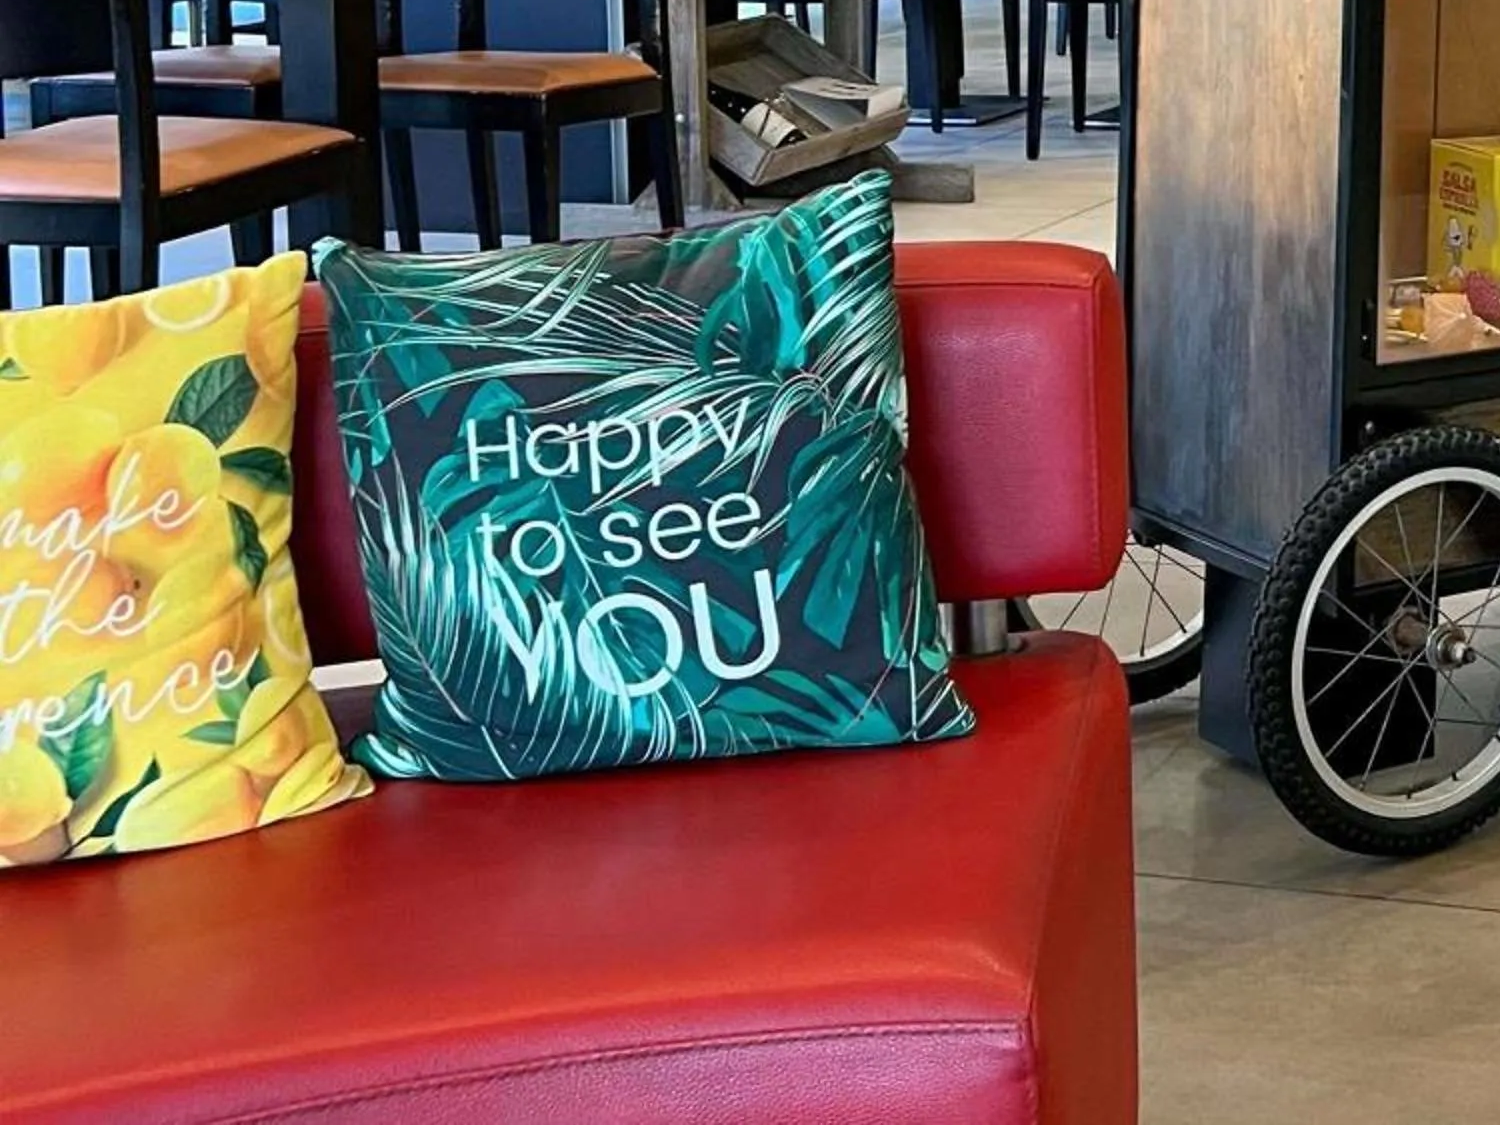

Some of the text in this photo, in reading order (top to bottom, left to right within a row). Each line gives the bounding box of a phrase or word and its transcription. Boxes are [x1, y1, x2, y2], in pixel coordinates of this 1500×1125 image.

[466, 397, 749, 495] Happy
[475, 492, 761, 577] to see
[0, 549, 167, 664] the
[490, 568, 780, 704] YOU
